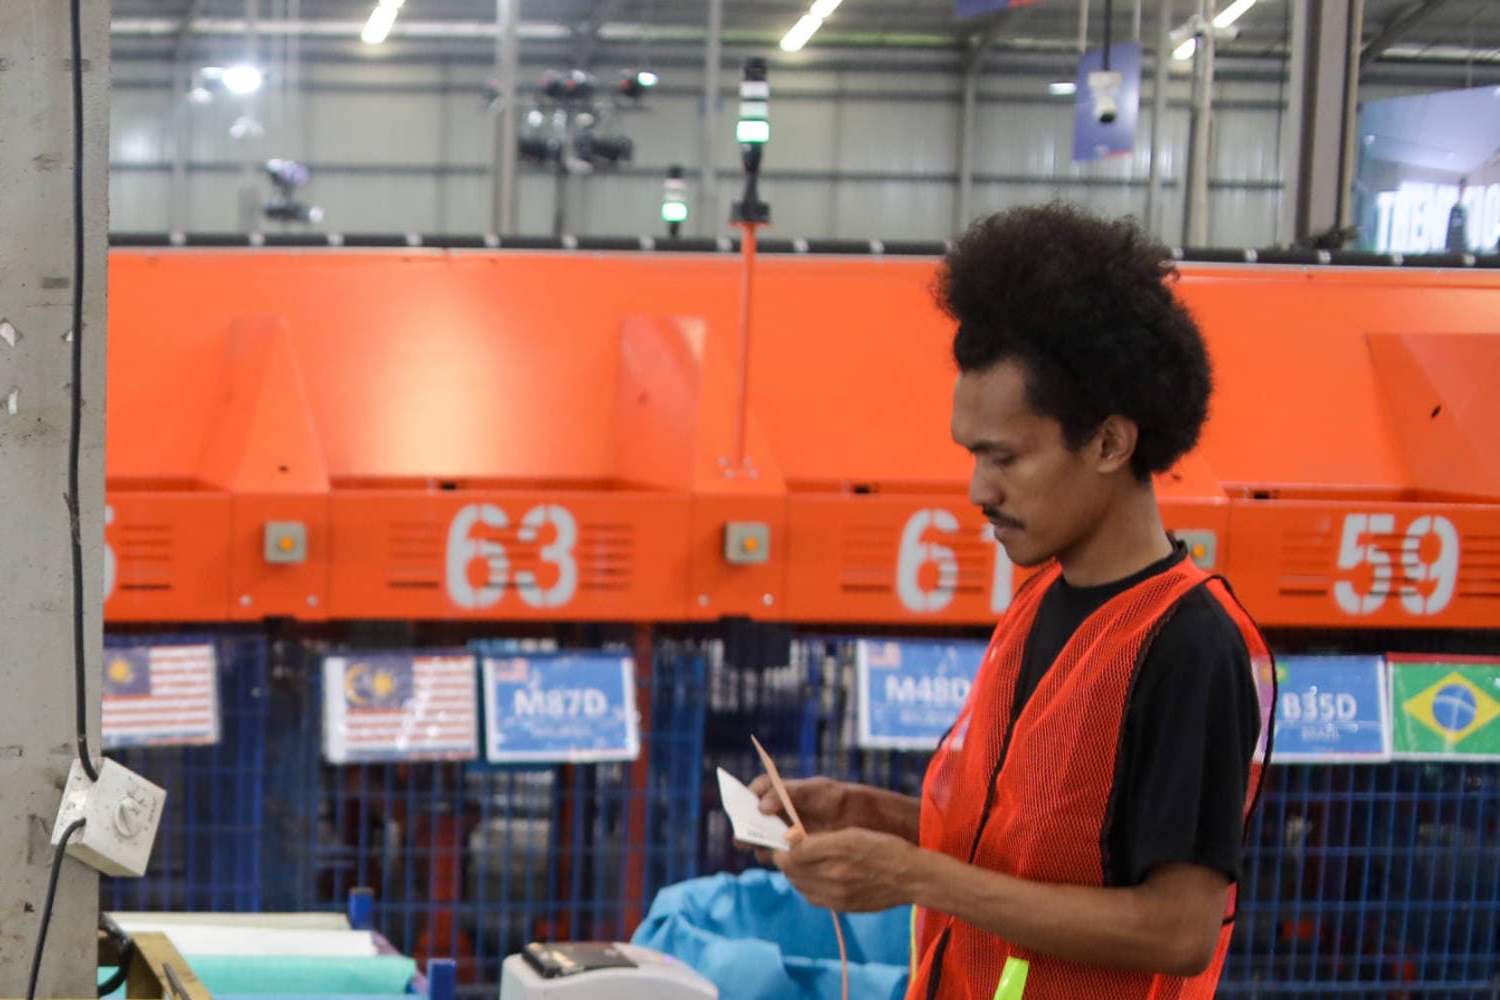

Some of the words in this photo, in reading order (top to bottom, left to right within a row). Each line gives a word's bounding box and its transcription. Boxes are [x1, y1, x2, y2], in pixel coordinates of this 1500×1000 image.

[446, 503, 577, 610] 63
[897, 508, 1014, 615] 61
[1334, 512, 1460, 616] 59
[515, 688, 608, 717] M87D
[1282, 692, 1358, 721] B35D
